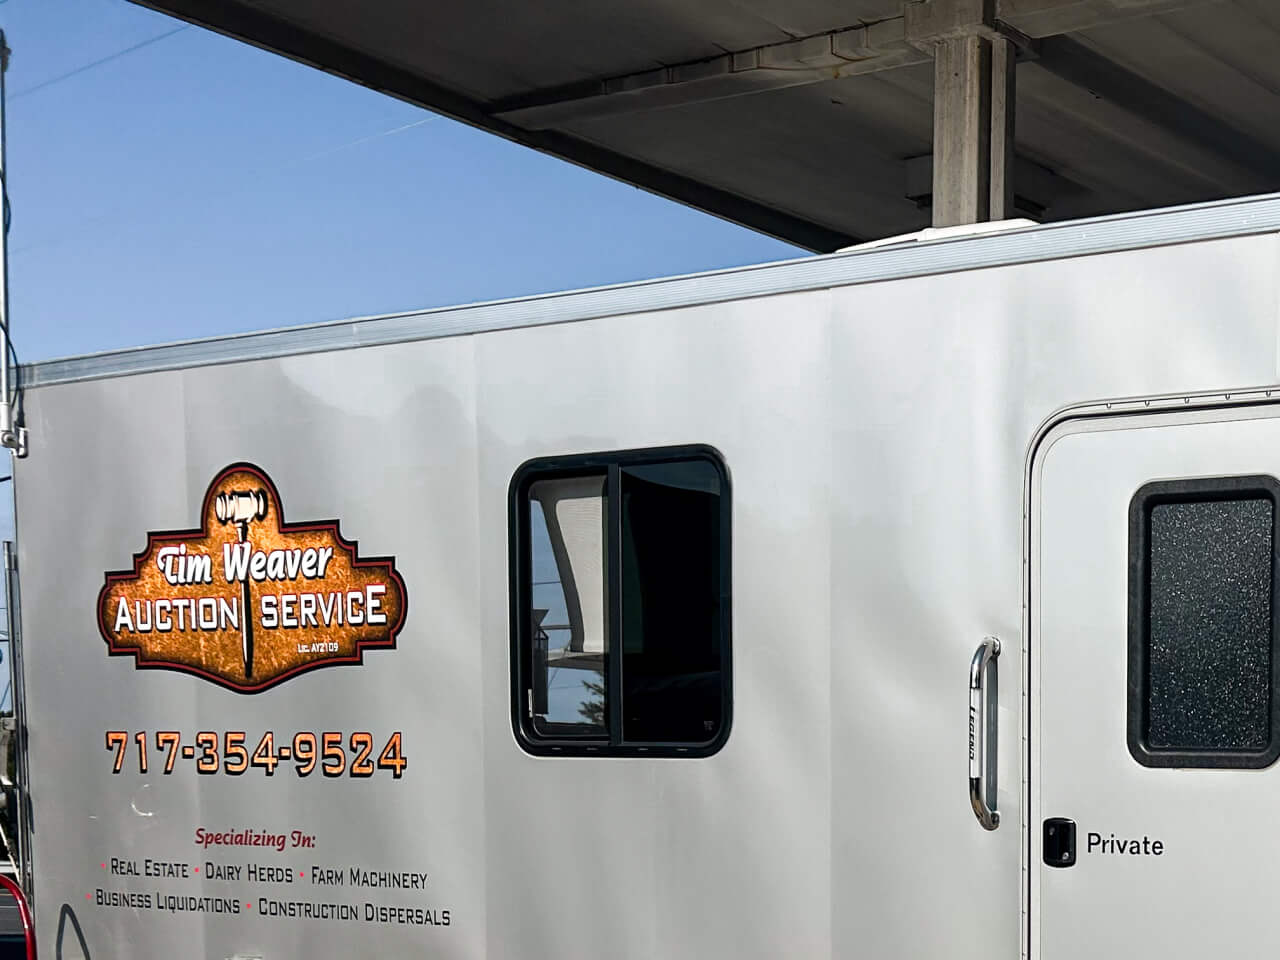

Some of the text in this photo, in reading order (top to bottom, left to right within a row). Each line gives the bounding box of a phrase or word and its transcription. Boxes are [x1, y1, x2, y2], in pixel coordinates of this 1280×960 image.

[157, 541, 333, 585] Tim Weaver
[113, 584, 387, 633] AUCTION SERVICE
[105, 730, 408, 779] 717-354-9524
[195, 827, 316, 852] Specializing In:
[1087, 832, 1164, 856] Private
[110, 857, 428, 890] REAL ESTATE DAIRY HERDS FARM MACHINERY
[96, 888, 451, 926] BUSINESS LIQUIDATIONS CONSTRUCTION DISPERSALS
